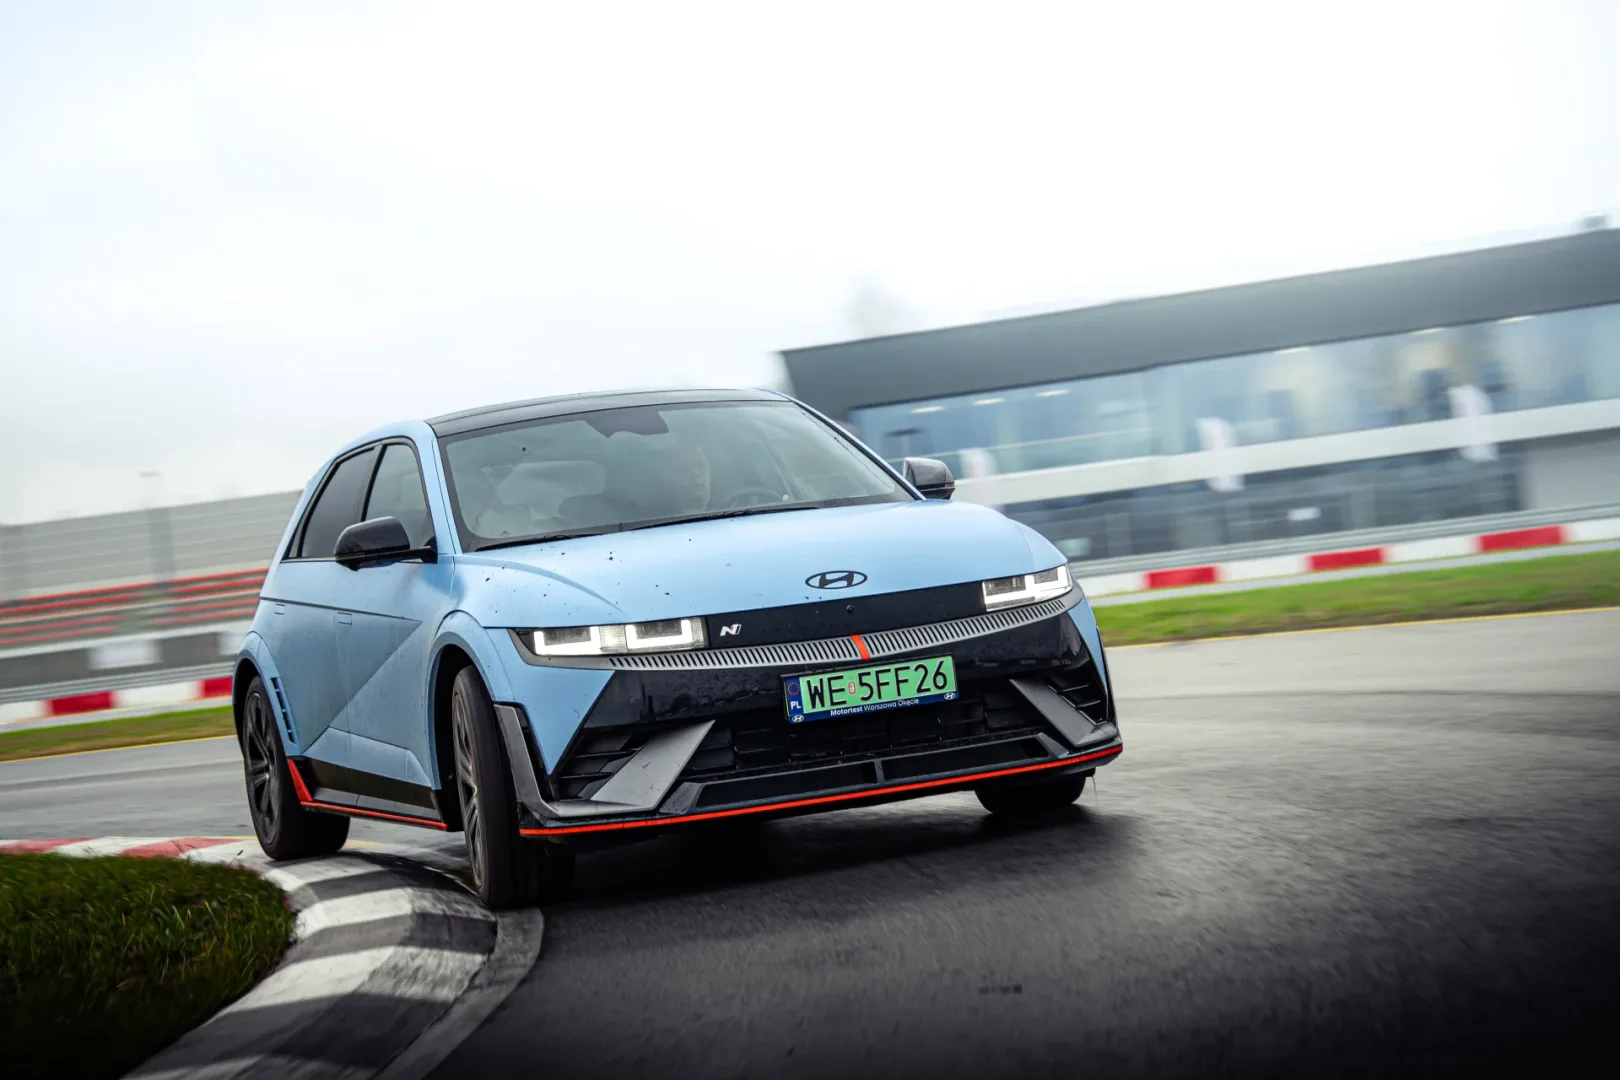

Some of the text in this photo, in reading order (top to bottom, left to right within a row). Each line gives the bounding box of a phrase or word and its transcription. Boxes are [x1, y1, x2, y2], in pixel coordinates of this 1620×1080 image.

[806, 660, 948, 709] WE 5FF26
[790, 700, 801, 710] PL
[830, 706, 863, 717] Motortest
[863, 701, 897, 712] Warszawa
